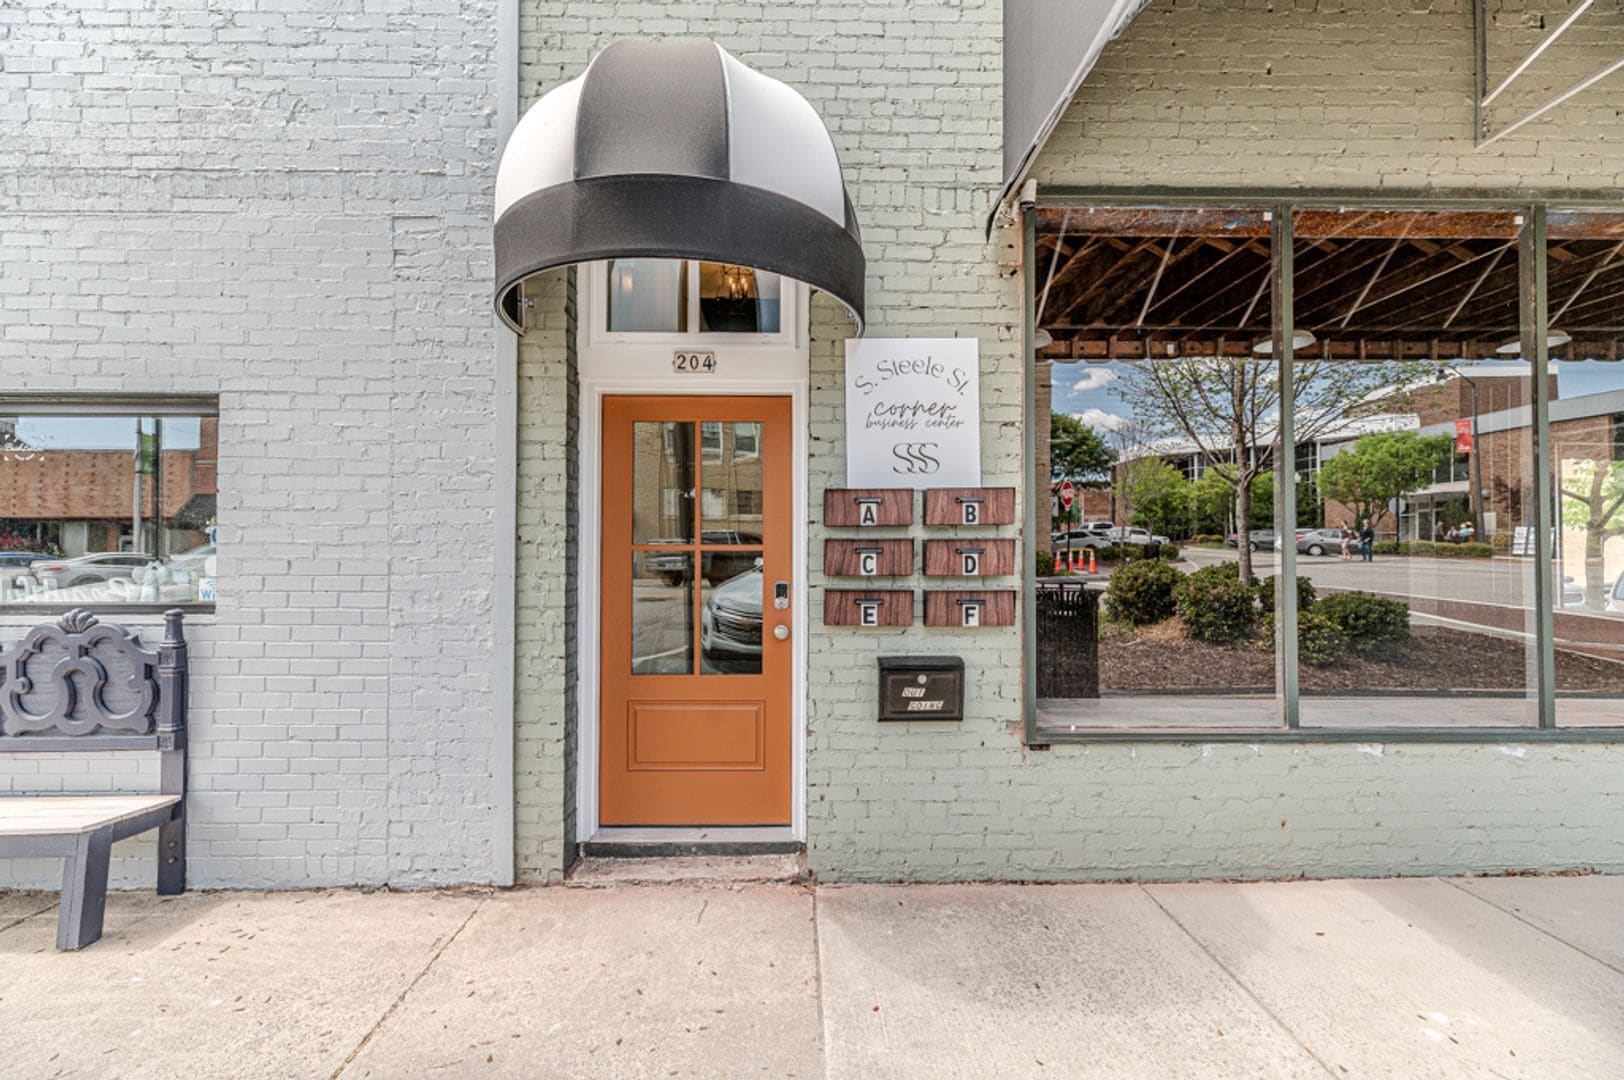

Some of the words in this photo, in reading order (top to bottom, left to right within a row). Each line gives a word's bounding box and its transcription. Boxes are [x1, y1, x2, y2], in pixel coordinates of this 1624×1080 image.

[676, 353, 713, 371] 204
[854, 374, 878, 395] S.
[876, 355, 945, 381] Steele
[873, 400, 958, 418] corner
[865, 412, 918, 430] business
[924, 414, 965, 430] center
[892, 442, 940, 474] SSS
[862, 505, 876, 524] A
[964, 504, 977, 523] B
[862, 554, 874, 574] C
[964, 555, 977, 574] D
[863, 605, 876, 624] E
[964, 605, 977, 624] F
